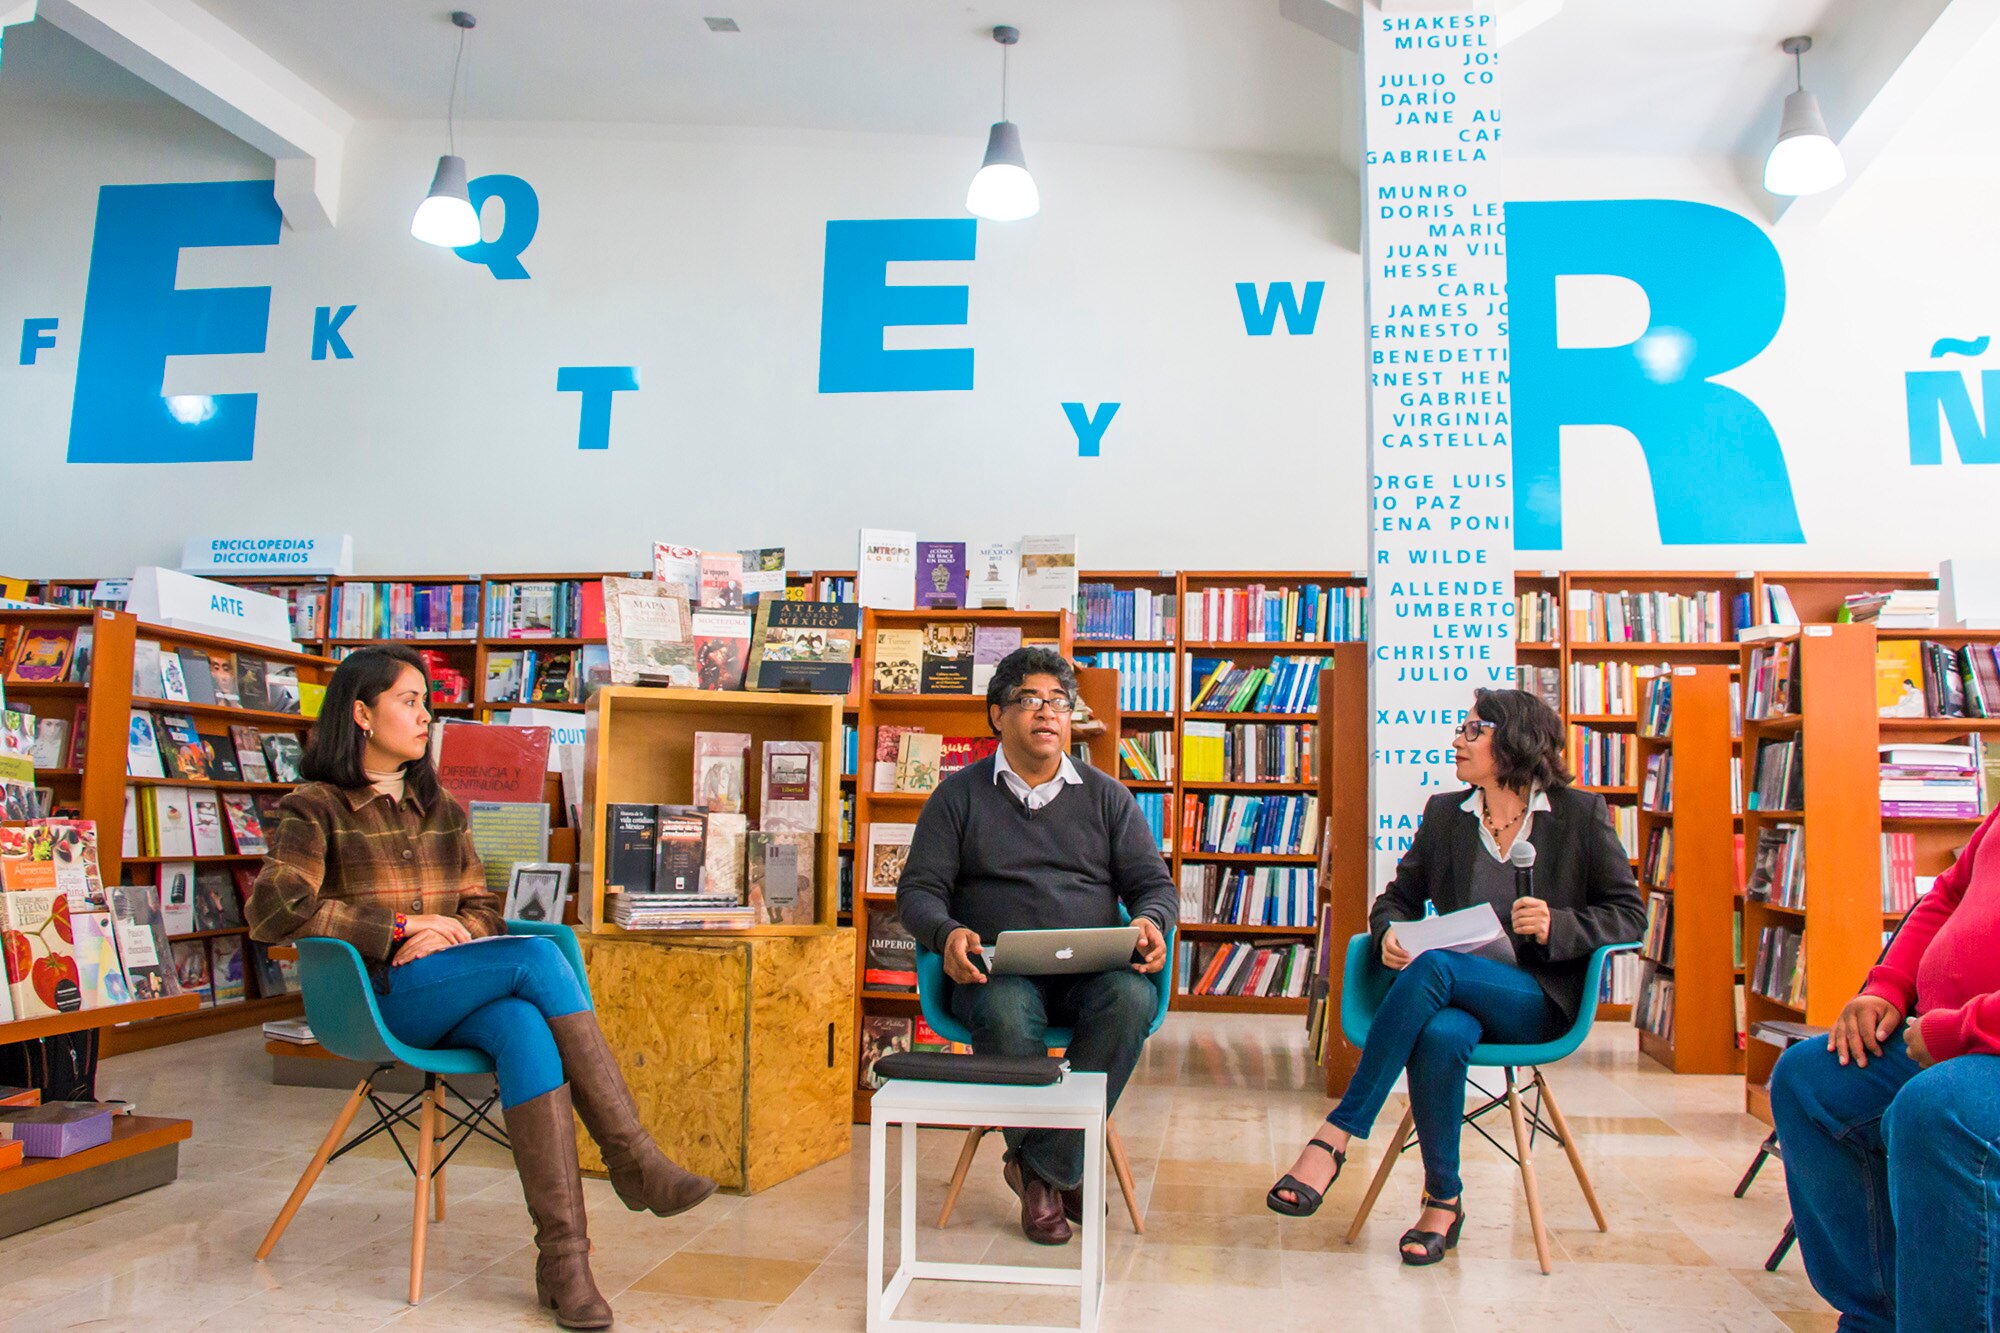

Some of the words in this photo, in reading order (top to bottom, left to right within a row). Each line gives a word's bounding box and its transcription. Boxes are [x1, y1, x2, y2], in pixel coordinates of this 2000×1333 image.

[1383, 15, 1497, 31] SHAKESP
[1395, 35, 1487, 49] MIGUEL
[1379, 73, 1445, 87] JULIO
[1464, 72, 1493, 84] CO
[1381, 89, 1456, 106] DARÍO
[1395, 111, 1453, 124] JANE
[1367, 149, 1486, 164] GABRIELA
[1379, 184, 1467, 199] MUNRO
[1381, 204, 1454, 219] DORIS
[453, 174, 539, 280] Q
[1386, 244, 1447, 258] JUAN
[1467, 243, 1503, 255] VIL
[1385, 264, 1457, 278] HESSE
[1438, 283, 1506, 296] CARL
[818, 219, 977, 393] E
[1236, 282, 1325, 335] W
[1388, 303, 1467, 317] JAMES
[66, 180, 282, 463] E
[312, 305, 356, 360] K
[1371, 323, 1478, 338] ERNESTO
[20, 318, 58, 365] F
[1374, 349, 1506, 363] BENEDETTI
[1504, 199, 1806, 550] R
[1401, 392, 1506, 406] GABRIEL
[1905, 335, 2000, 465] Ñ
[557, 366, 640, 450] T
[1393, 413, 1508, 426] VIRGINIA
[1062, 403, 1120, 456] Y
[1383, 433, 1506, 447] CASTELLA
[1453, 475, 1505, 488] LUIS
[1416, 496, 1460, 509] PAZ
[1374, 517, 1431, 530] ENA
[1451, 517, 1508, 530] PONI
[211, 539, 315, 551] ENCICLOPEDIAS
[866, 545, 911, 556] ANTROPO
[213, 552, 309, 564] DICCIONARIOS
[1378, 551, 1389, 563] R
[1409, 550, 1486, 563] WILDE
[1391, 582, 1503, 595] ALLENDE
[210, 594, 244, 617] ARTE
[632, 600, 666, 611] MAPA
[780, 604, 840, 613] ATLAS
[1396, 603, 1514, 617] UMBERTO
[698, 617, 747, 626] MOCTEZUMA
[778, 618, 839, 627] MÉXICO
[1434, 624, 1508, 638] LEWIS
[1377, 646, 1490, 660] CHRISTIE
[1398, 668, 1468, 681] JULIO
[1488, 667, 1516, 680] VE
[441, 766, 508, 778] DIFERENCIA
[514, 767, 522, 779] Y
[1420, 772, 1440, 786] J.
[15, 865, 53, 875] Alimentos
